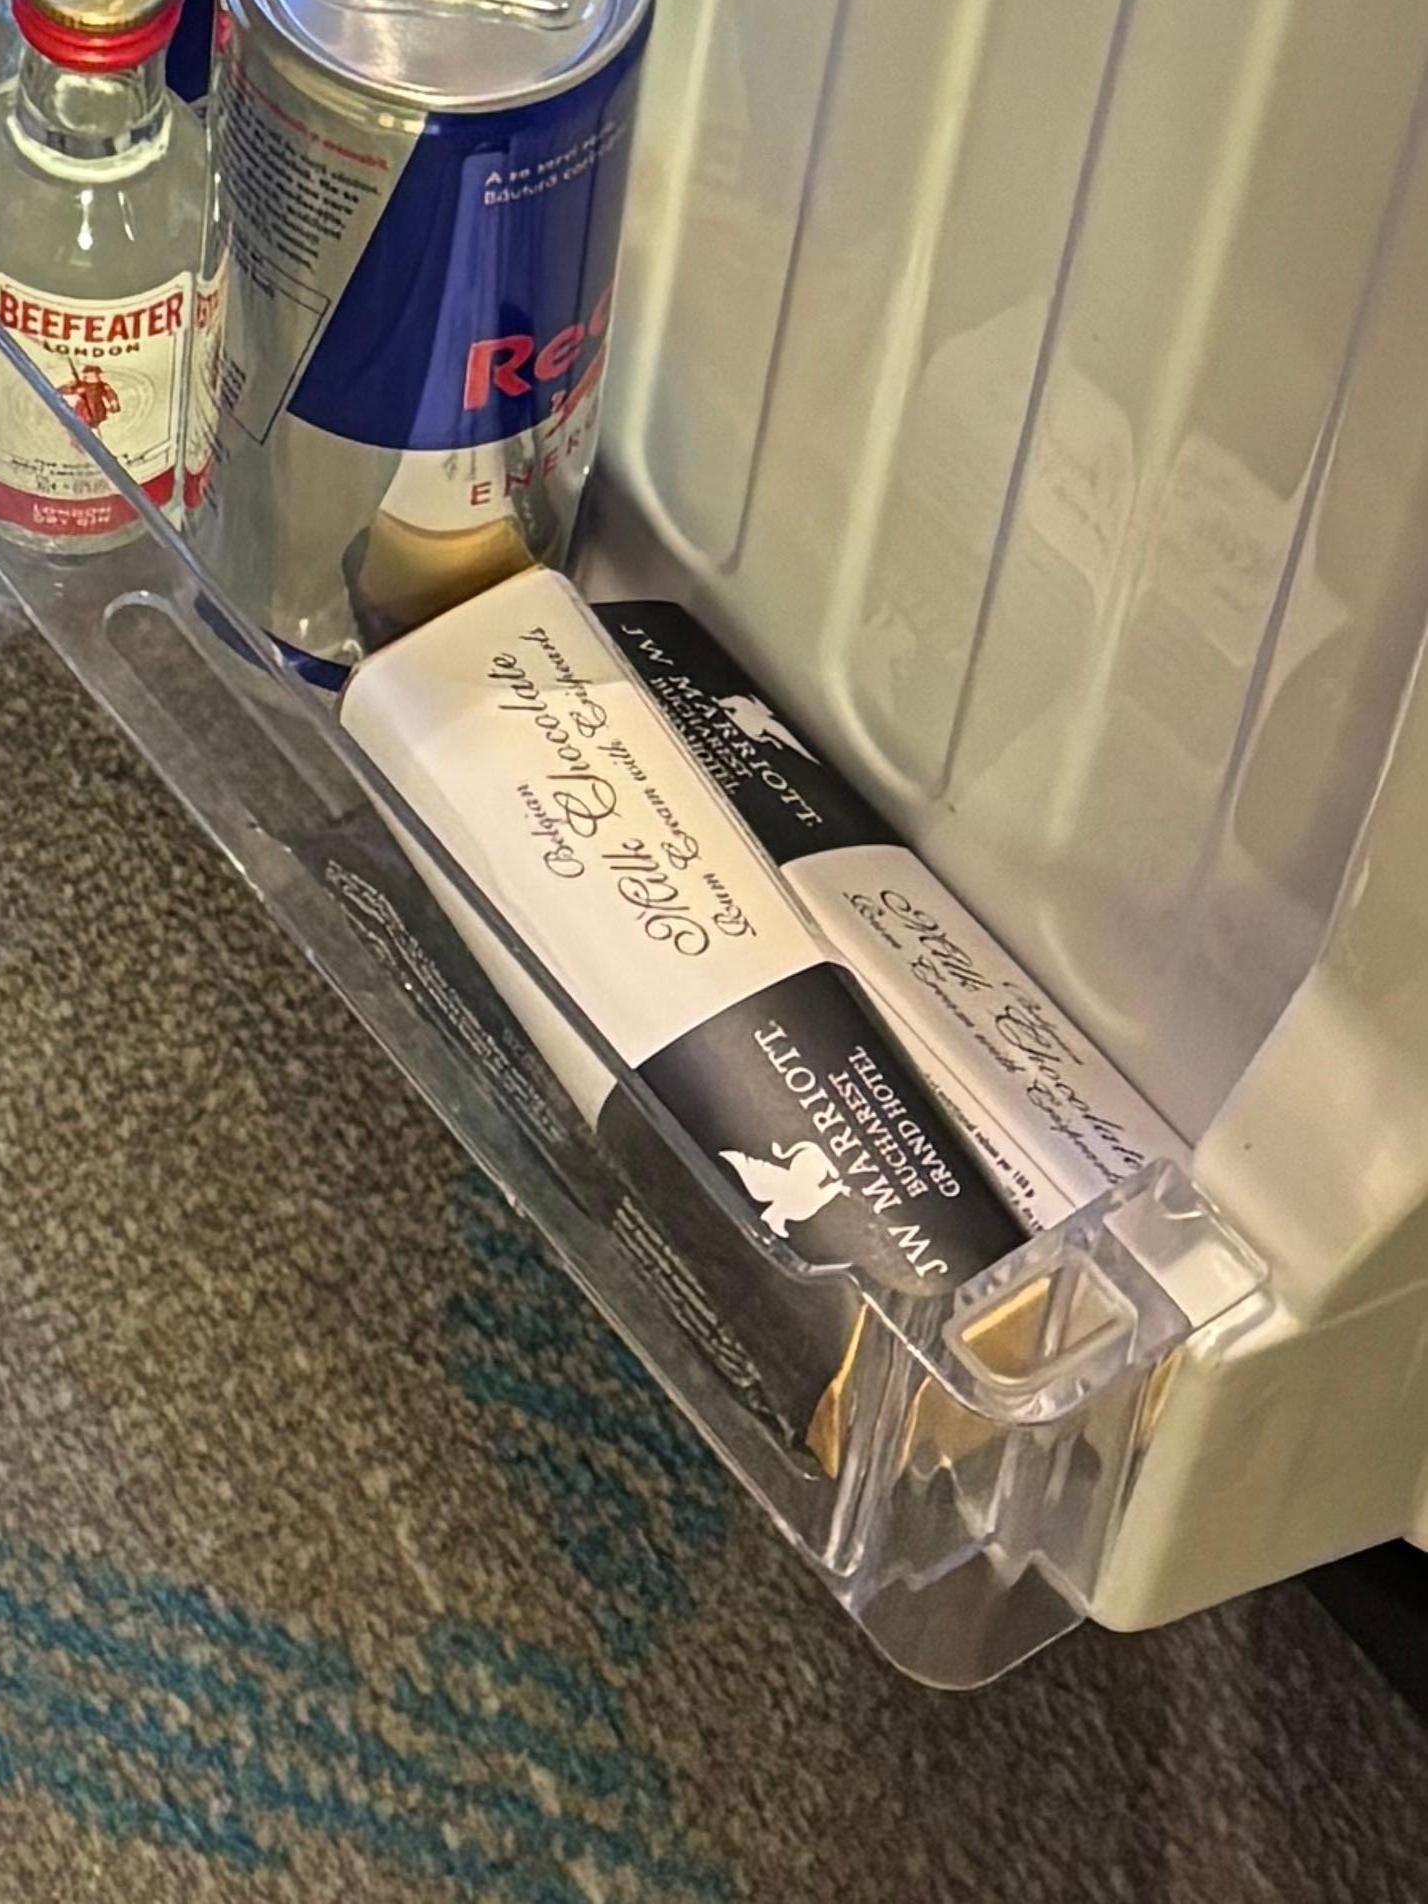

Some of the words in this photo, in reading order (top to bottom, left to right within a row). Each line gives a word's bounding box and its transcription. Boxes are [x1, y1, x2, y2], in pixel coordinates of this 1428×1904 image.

[43, 341, 141, 359] LONDON
[487, 652, 622, 838] Chocolate
[597, 738, 649, 782] with
[669, 672, 824, 824] MARRIOTT
[516, 783, 585, 879] Belgian
[643, 787, 703, 870] Cream
[601, 836, 711, 957] Milk
[702, 872, 757, 938] Rum
[754, 1024, 903, 1215] MARRIOTT
[848, 1045, 907, 1119] HOTEL
[827, 1071, 929, 1198] BUCHAREST
[898, 1118, 961, 1198] GRAND
[887, 1223, 949, 1278] JW
